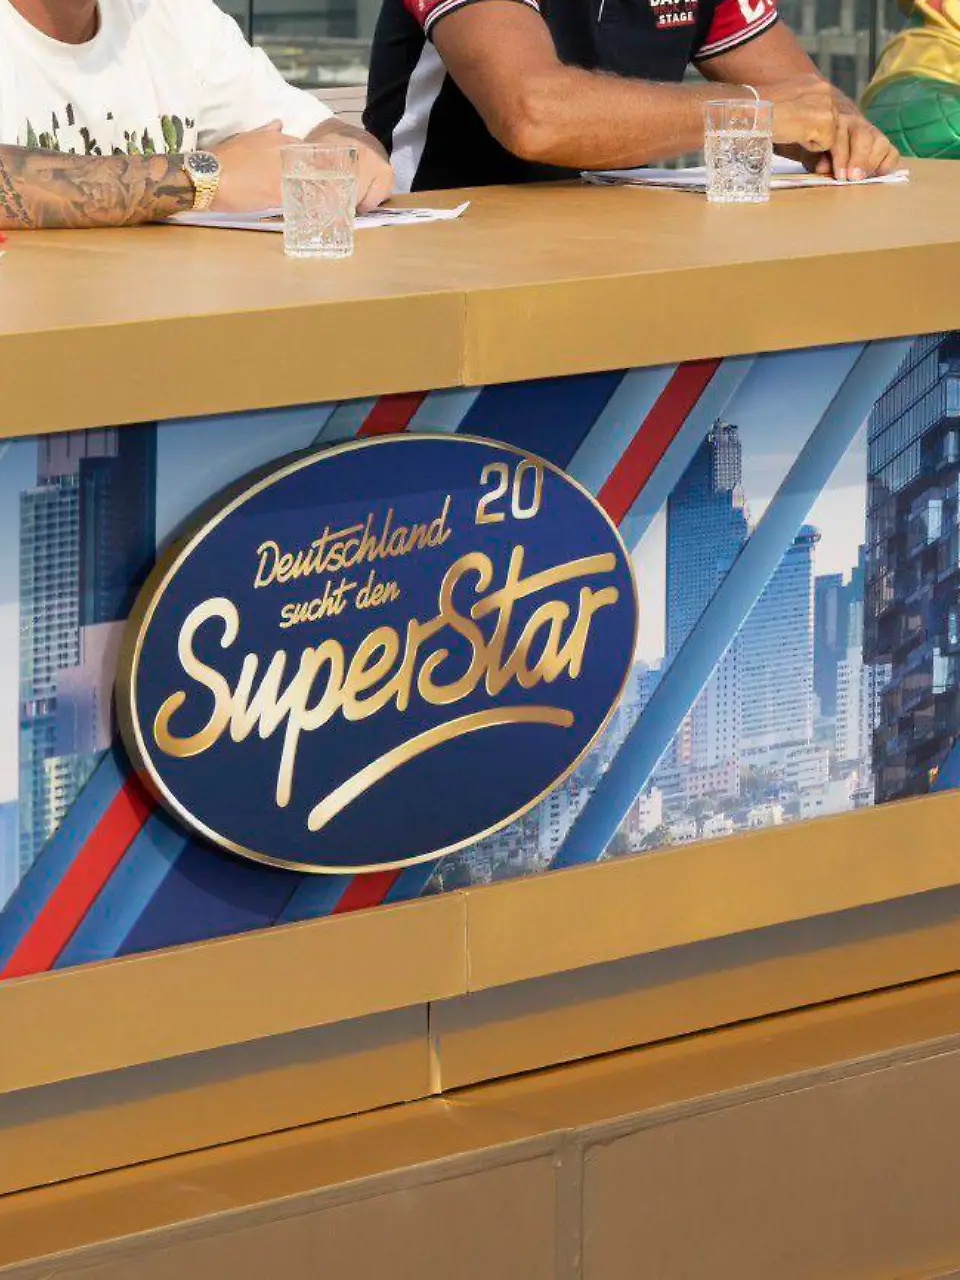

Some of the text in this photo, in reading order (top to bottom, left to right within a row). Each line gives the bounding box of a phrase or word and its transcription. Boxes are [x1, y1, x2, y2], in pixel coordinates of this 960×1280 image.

[659, 11, 693, 24] STAGE
[475, 459, 543, 526] 20
[253, 495, 452, 589] Deutschland
[279, 570, 401, 630] sucht den
